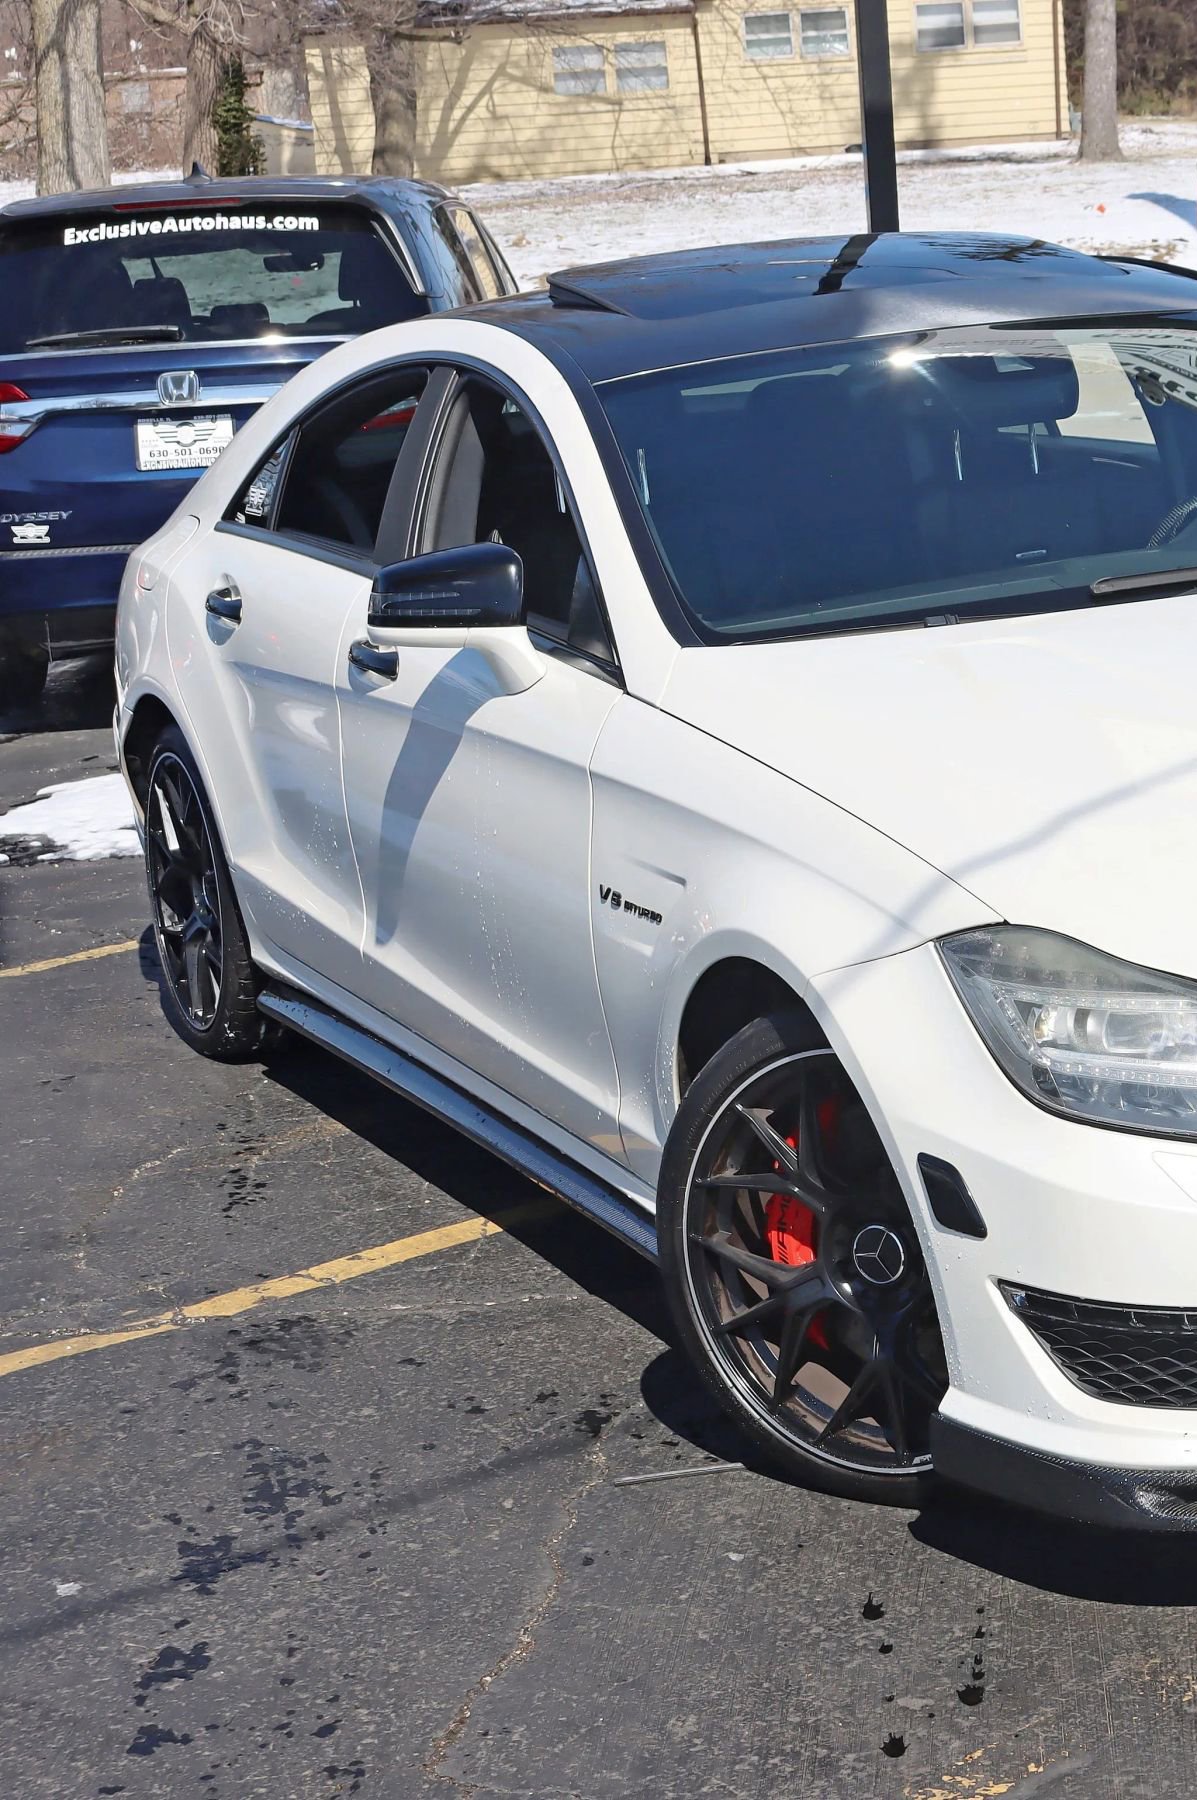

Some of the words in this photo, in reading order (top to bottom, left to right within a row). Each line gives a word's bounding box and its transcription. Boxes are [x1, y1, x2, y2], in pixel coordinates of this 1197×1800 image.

[63, 213, 320, 246] ExclusiveAutohaus.com
[599, 884, 622, 911] V8
[623, 899, 663, 926] BITURBO
